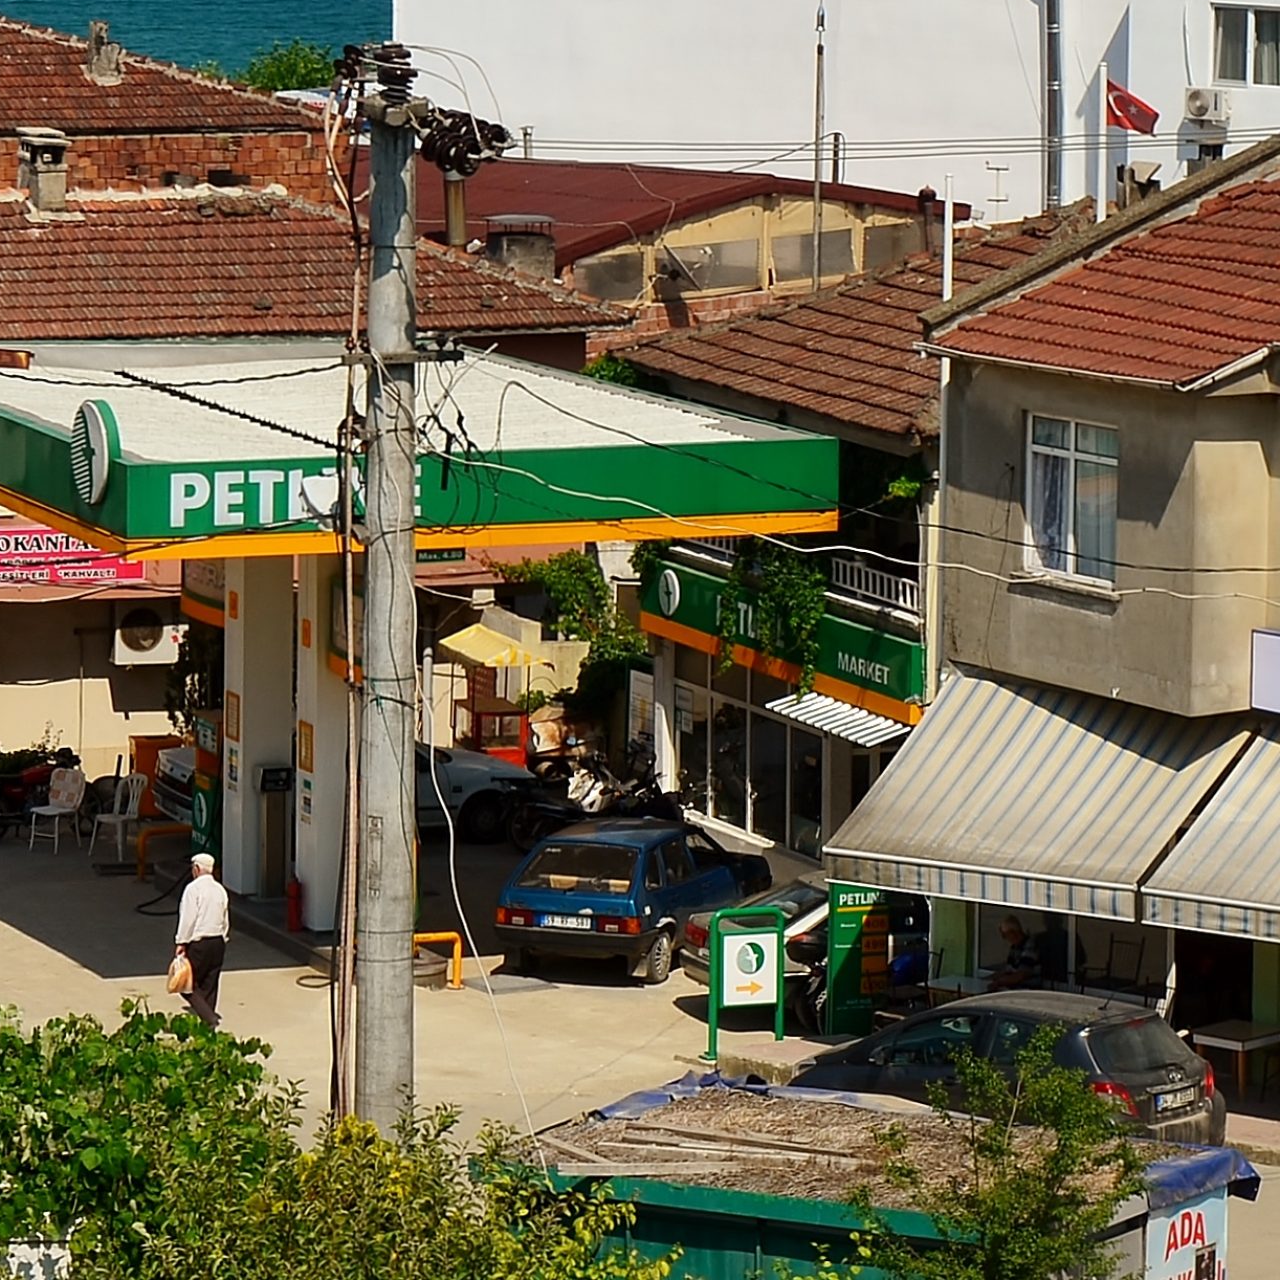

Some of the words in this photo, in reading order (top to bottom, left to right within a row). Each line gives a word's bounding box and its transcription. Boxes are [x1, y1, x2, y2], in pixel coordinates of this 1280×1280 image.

[170, 464, 421, 528] PETL
[63, 570, 116, 578] KAHVALTI
[838, 651, 890, 686] MARKET
[839, 891, 886, 906] PETLINE
[1165, 1211, 1206, 1262] ADA
